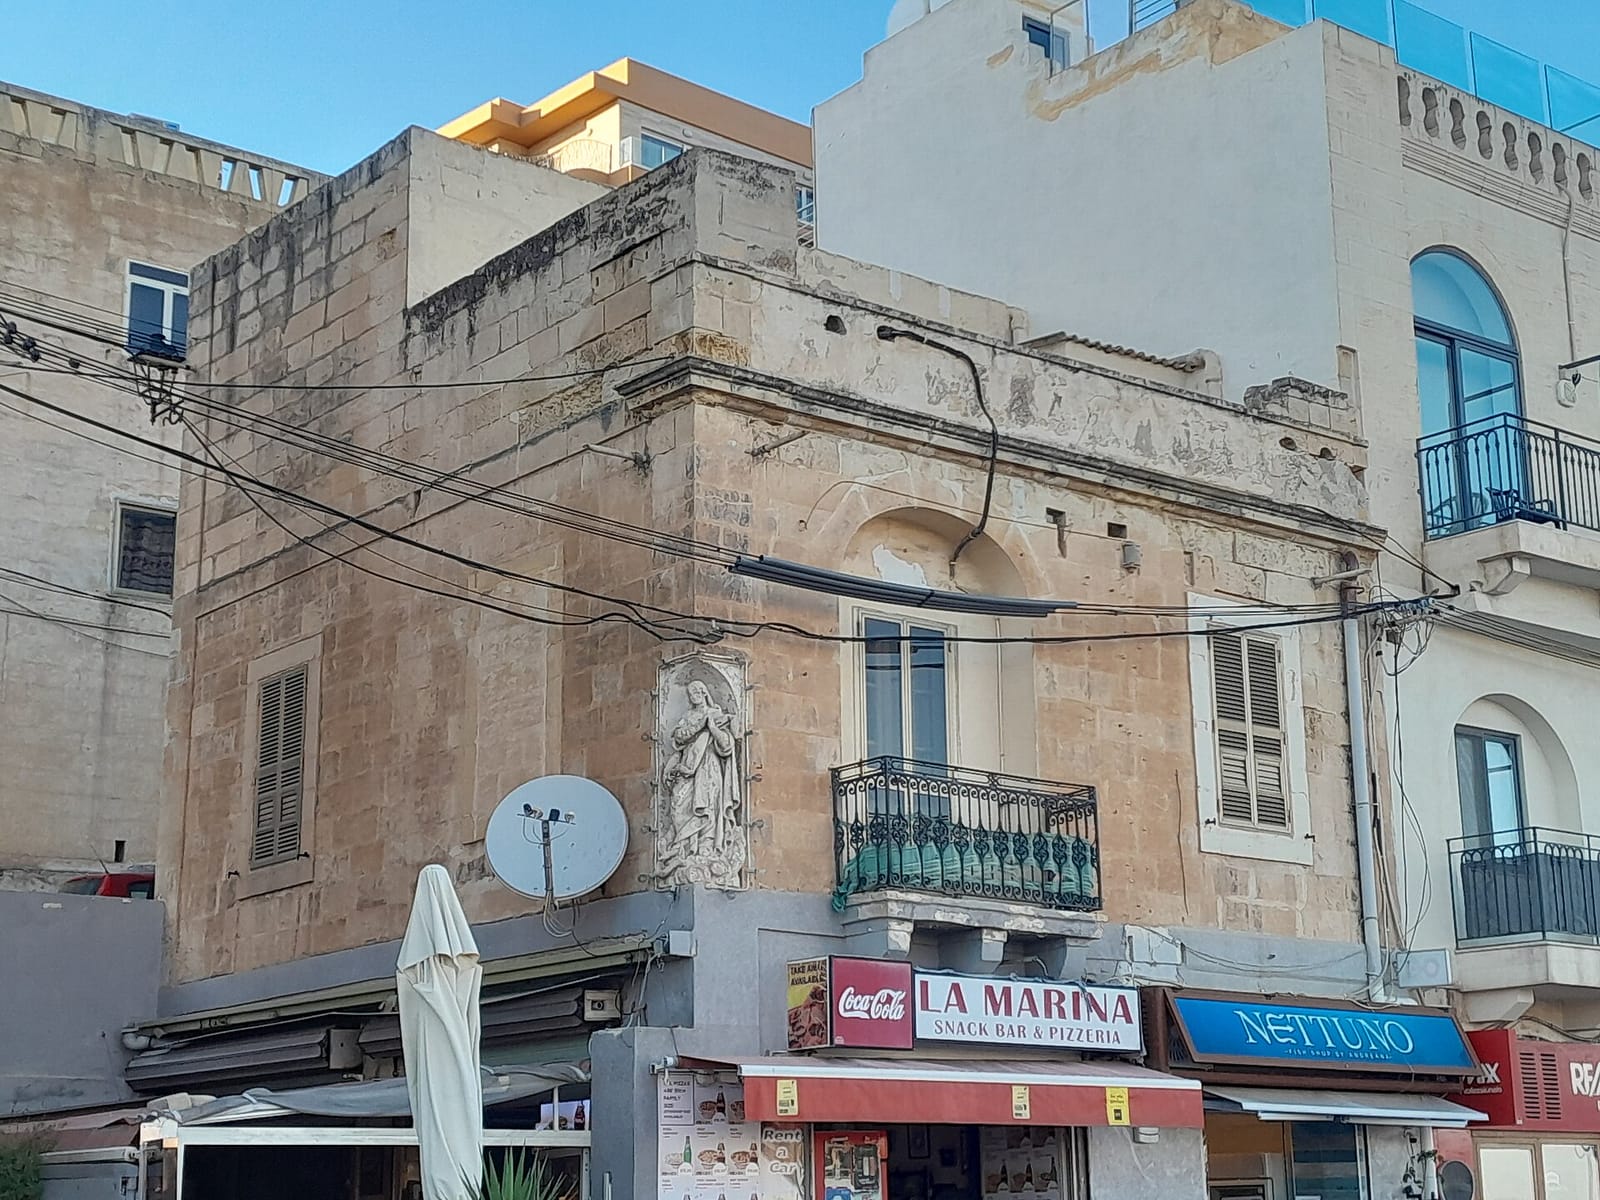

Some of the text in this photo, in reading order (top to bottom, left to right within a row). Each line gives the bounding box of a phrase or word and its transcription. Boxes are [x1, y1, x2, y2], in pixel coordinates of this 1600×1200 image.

[838, 986, 906, 1021] Coca-Cola
[919, 980, 1134, 1025] LA MARINA
[934, 1019, 1121, 1045] SNACK BAR & PIZZERIA
[1233, 1010, 1415, 1054] NETTUNO
[763, 1129, 803, 1141] Rent
[777, 1147, 787, 1157] a
[769, 1161, 797, 1174] Car
